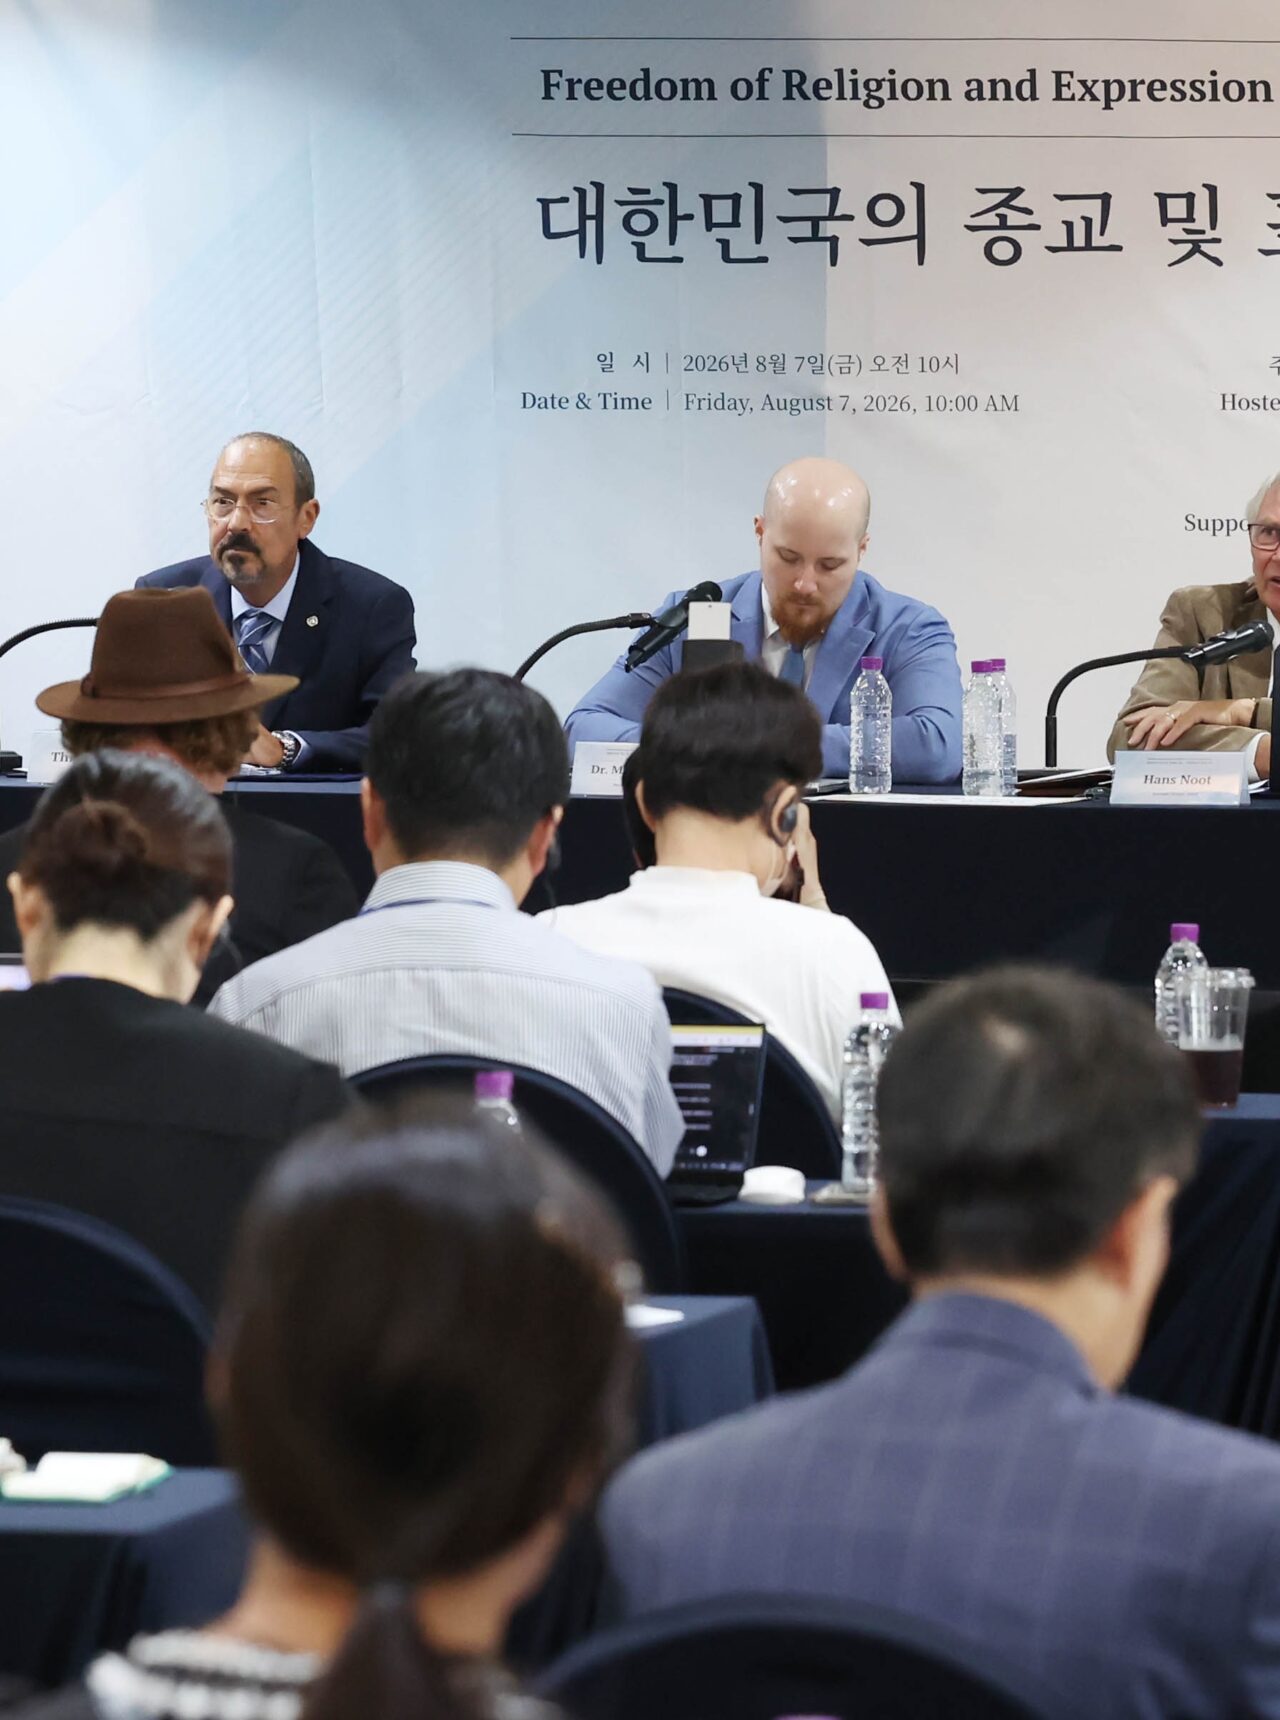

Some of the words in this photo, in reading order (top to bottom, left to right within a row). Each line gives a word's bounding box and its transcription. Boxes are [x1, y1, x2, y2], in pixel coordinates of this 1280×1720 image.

[540, 67, 718, 102] Freedom
[730, 67, 774, 102] of
[781, 67, 953, 110] Religion
[964, 67, 1040, 102] and
[1051, 69, 1275, 111] Expression
[536, 180, 926, 268] 대한민국의
[963, 185, 1124, 267] 종교
[1153, 182, 1224, 268] 및
[683, 352, 749, 375] 2026년
[755, 352, 787, 375] 8월
[794, 353, 862, 377] 7일(금)
[869, 353, 909, 375] 오전
[919, 353, 959, 375] 10시
[521, 391, 570, 410] Date
[575, 392, 591, 410] &
[597, 391, 653, 410] Time
[684, 391, 754, 417] Friday,
[760, 393, 833, 417] August
[839, 395, 857, 415] 7,
[863, 394, 917, 414] 2026,
[926, 395, 978, 412] 10:00
[983, 395, 1019, 412] AM
[1184, 513, 1249, 537] Suppo
[591, 764, 607, 775] Dr.
[1143, 774, 1177, 785] Hans
[1180, 774, 1212, 785] Noot
